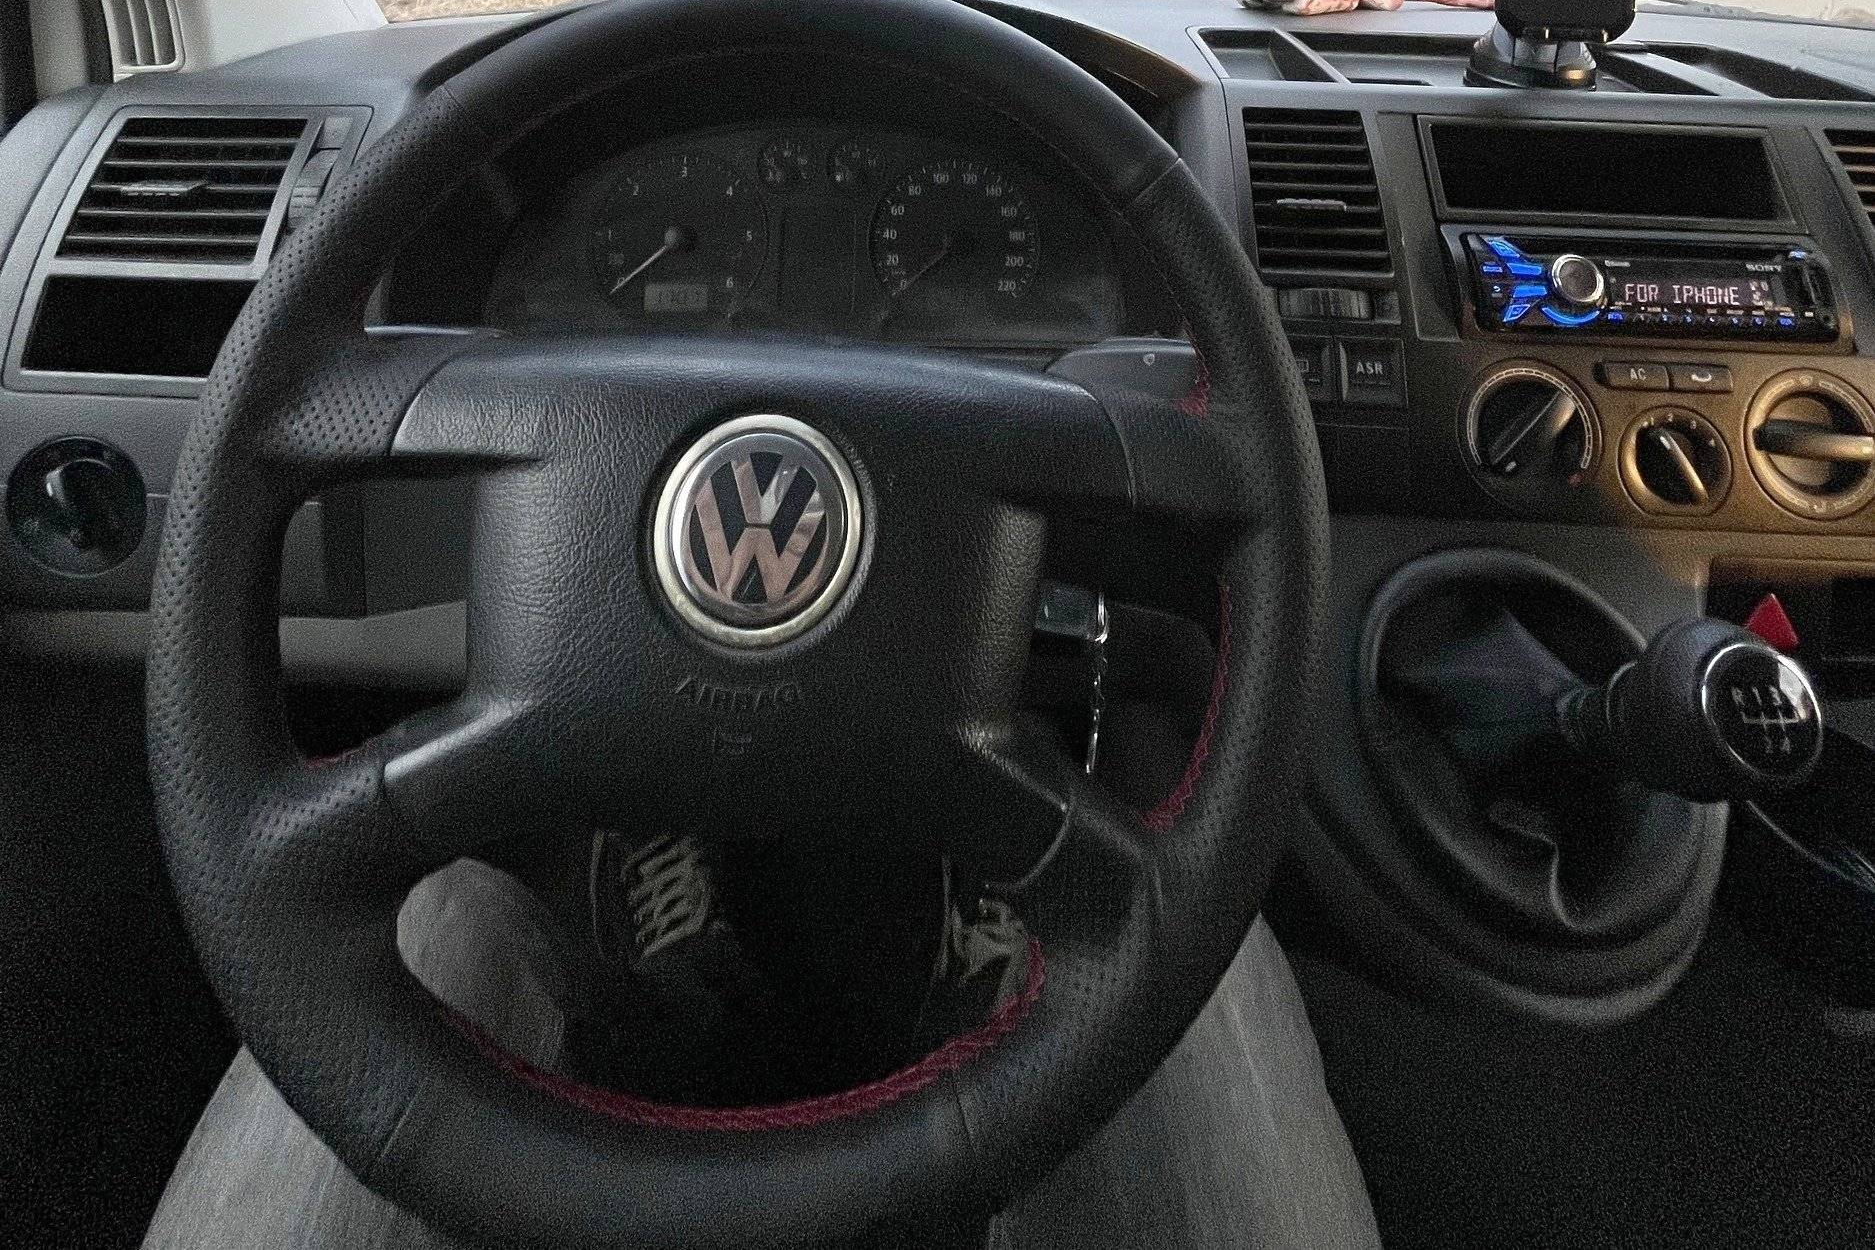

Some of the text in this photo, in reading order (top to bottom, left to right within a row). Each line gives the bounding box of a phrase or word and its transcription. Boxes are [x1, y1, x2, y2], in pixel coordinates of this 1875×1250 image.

[680, 165, 689, 179] 3
[932, 172, 950, 184] 100
[961, 172, 979, 184] 120
[632, 183, 640, 197] 2
[725, 185, 734, 198] 4
[907, 184, 923, 197] 80
[985, 185, 1003, 197] 140
[889, 204, 906, 217] 60
[1000, 206, 1018, 218] 160
[745, 229, 753, 242] 5
[882, 228, 898, 240] 40
[1008, 229, 1026, 241] 180
[886, 254, 899, 267] 20
[1004, 255, 1025, 267] 200
[1745, 263, 1782, 273] SONY
[725, 276, 735, 289] 6
[997, 279, 1017, 292] 220
[1624, 283, 1659, 303] FOR
[1672, 285, 1741, 306] IPHONE
[1355, 361, 1384, 375] ASR
[1629, 367, 1647, 380] AC
[688, 448, 828, 605] VW
[1731, 685, 1783, 707] R 1 3
[1780, 736, 1792, 755] 4
